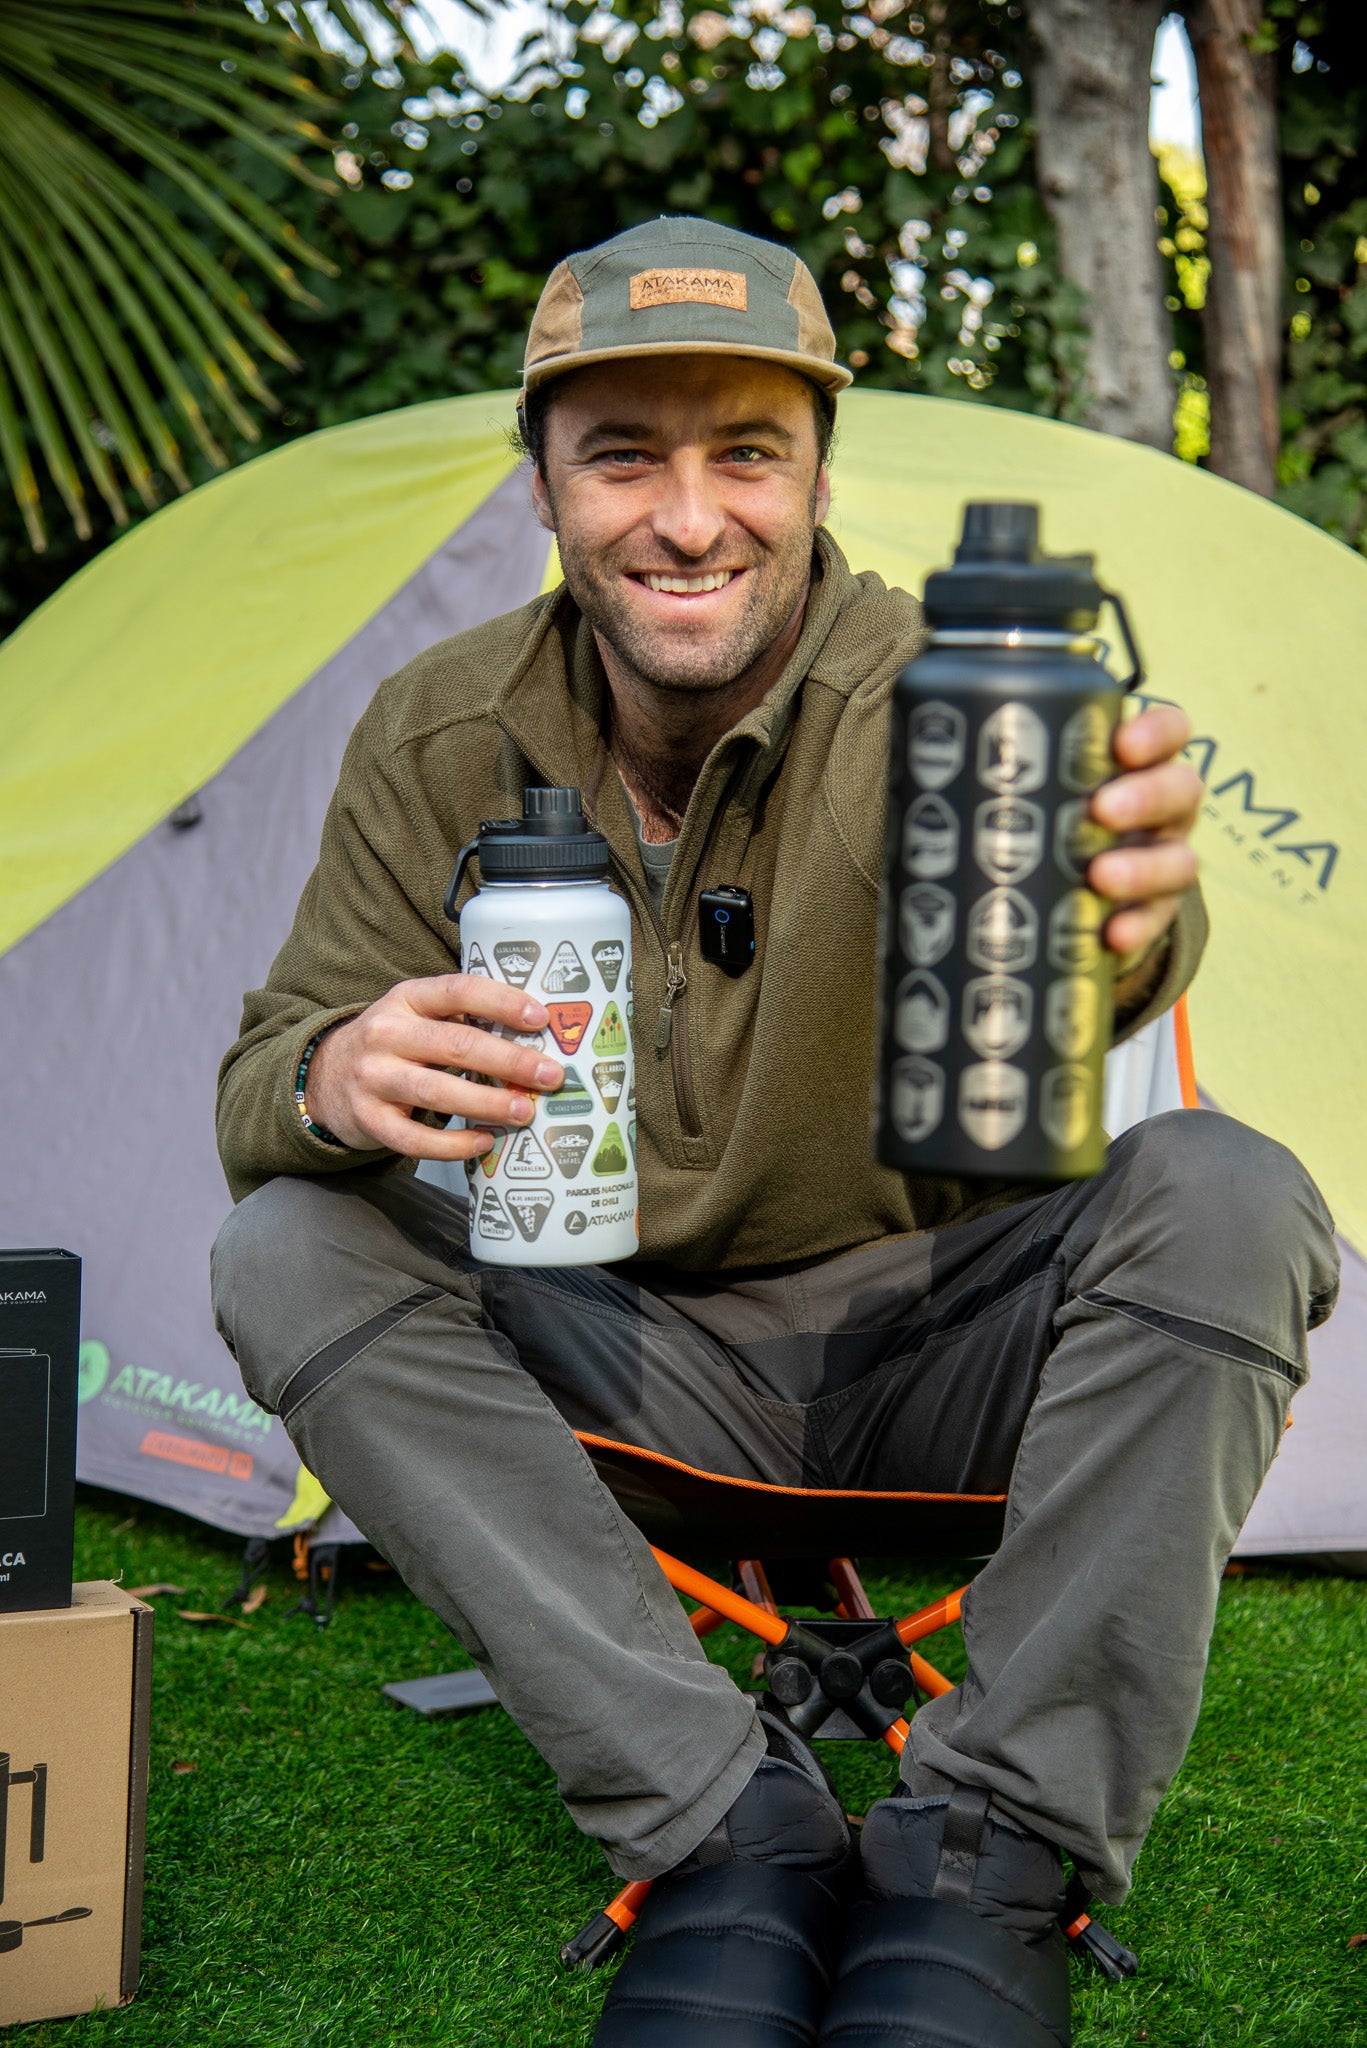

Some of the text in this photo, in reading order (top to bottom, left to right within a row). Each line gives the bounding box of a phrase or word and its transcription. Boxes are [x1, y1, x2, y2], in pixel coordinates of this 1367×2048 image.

[641, 276, 734, 292] ATAKAMA
[565, 1187, 600, 1197] PARQUES
[591, 1196, 619, 1208] DE CHILE
[109, 1363, 273, 1435] ATAKAMA
[0, 1552, 26, 1567] CA
